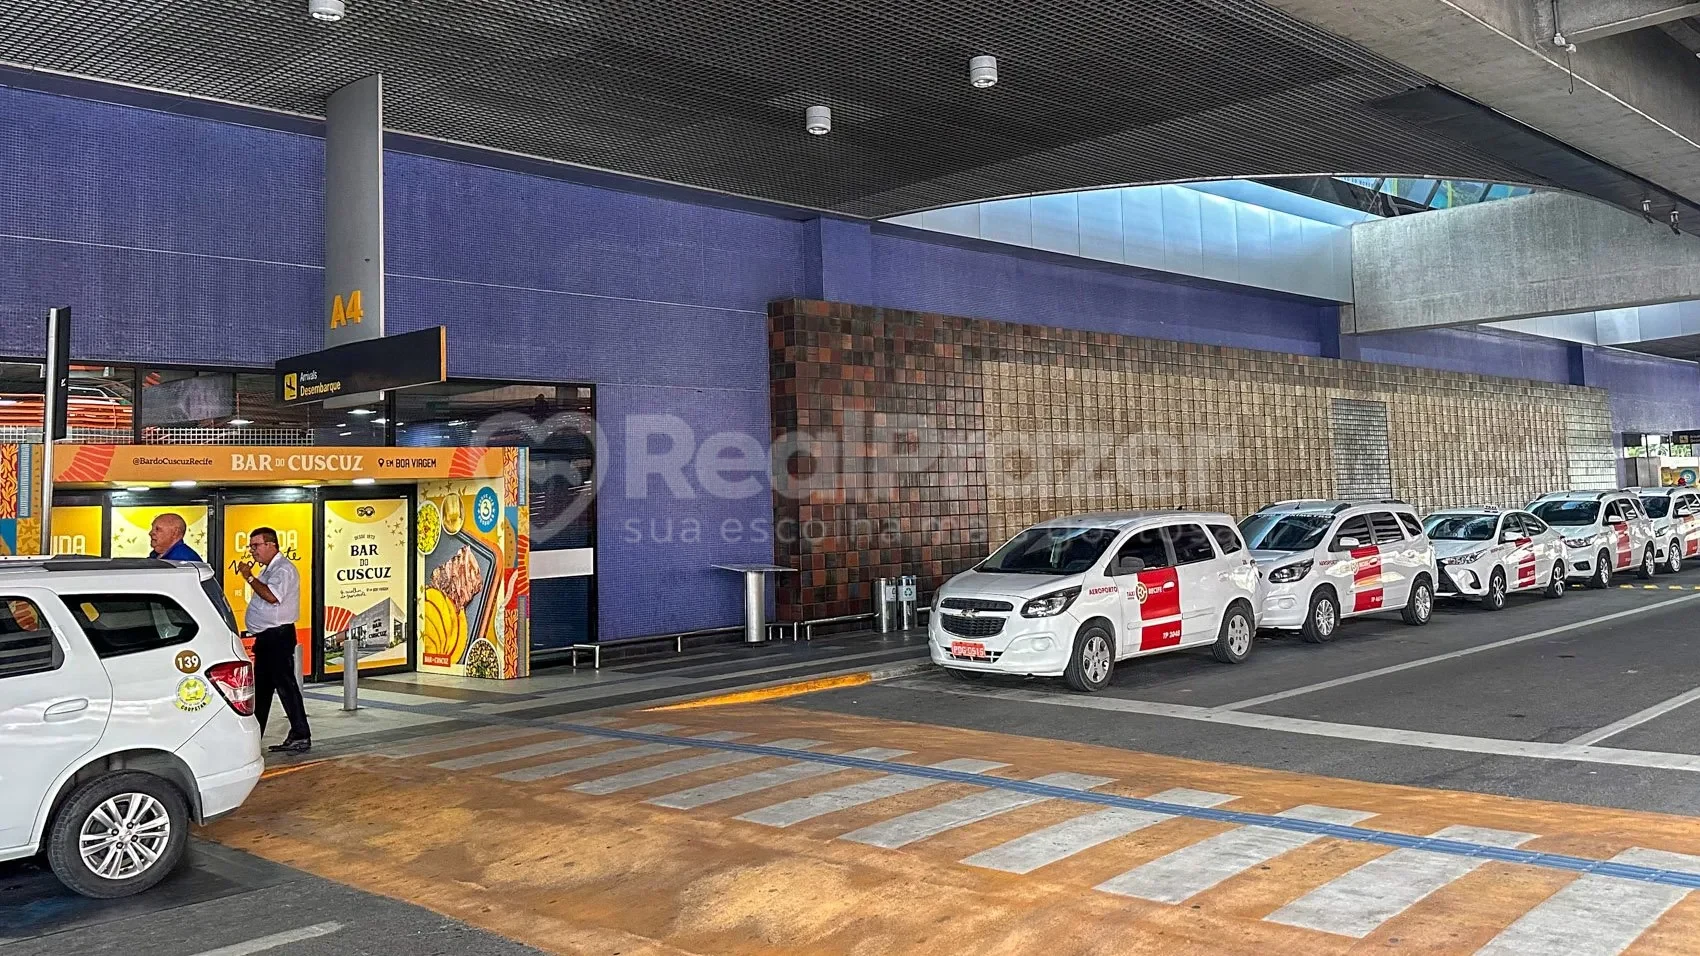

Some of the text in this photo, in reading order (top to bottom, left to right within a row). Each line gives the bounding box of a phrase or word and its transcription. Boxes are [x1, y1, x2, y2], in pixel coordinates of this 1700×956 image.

[330, 290, 363, 329] A4
[300, 369, 318, 383] Arrivals
[300, 380, 341, 397] Desembarque
[132, 457, 213, 466] @BardoCuscuzRecife
[231, 453, 364, 471] BAR DO CUSCUZ
[395, 458, 410, 468] BOA
[411, 458, 437, 468] VIAGEM
[482, 501, 490, 518] 3
[350, 544, 379, 557] BAR
[336, 566, 392, 581] CUSCUZ
[1089, 586, 1118, 595] AEROPORTO
[177, 655, 199, 670] 139
